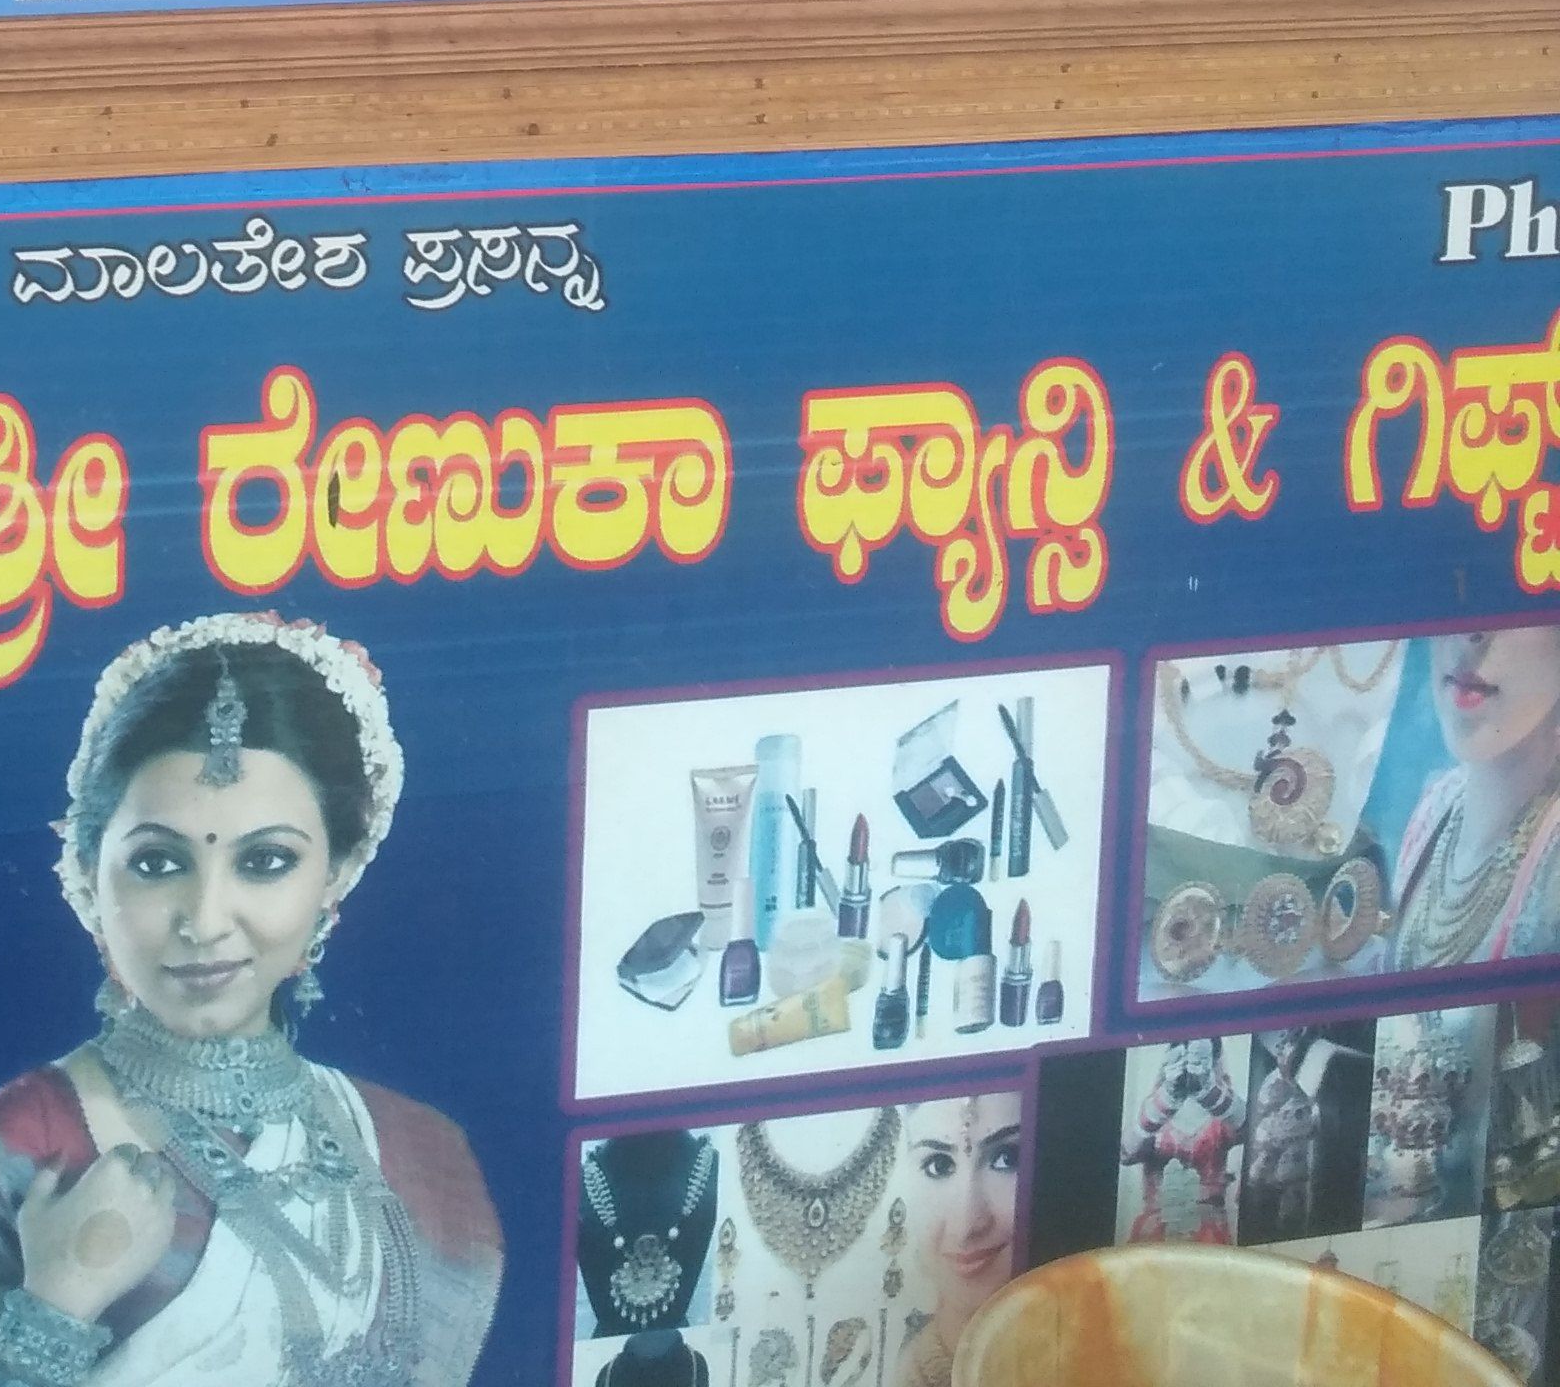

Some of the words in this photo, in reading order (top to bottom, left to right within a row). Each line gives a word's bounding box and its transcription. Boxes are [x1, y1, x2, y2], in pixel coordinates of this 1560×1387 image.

[12, 216, 368, 305] ಮಾಲತೇಶ
[402, 220, 607, 312] ಪ್ರಸನ್ನ
[199, 365, 733, 594] ರೇಣುಕಾ
[1181, 351, 1279, 524] &
